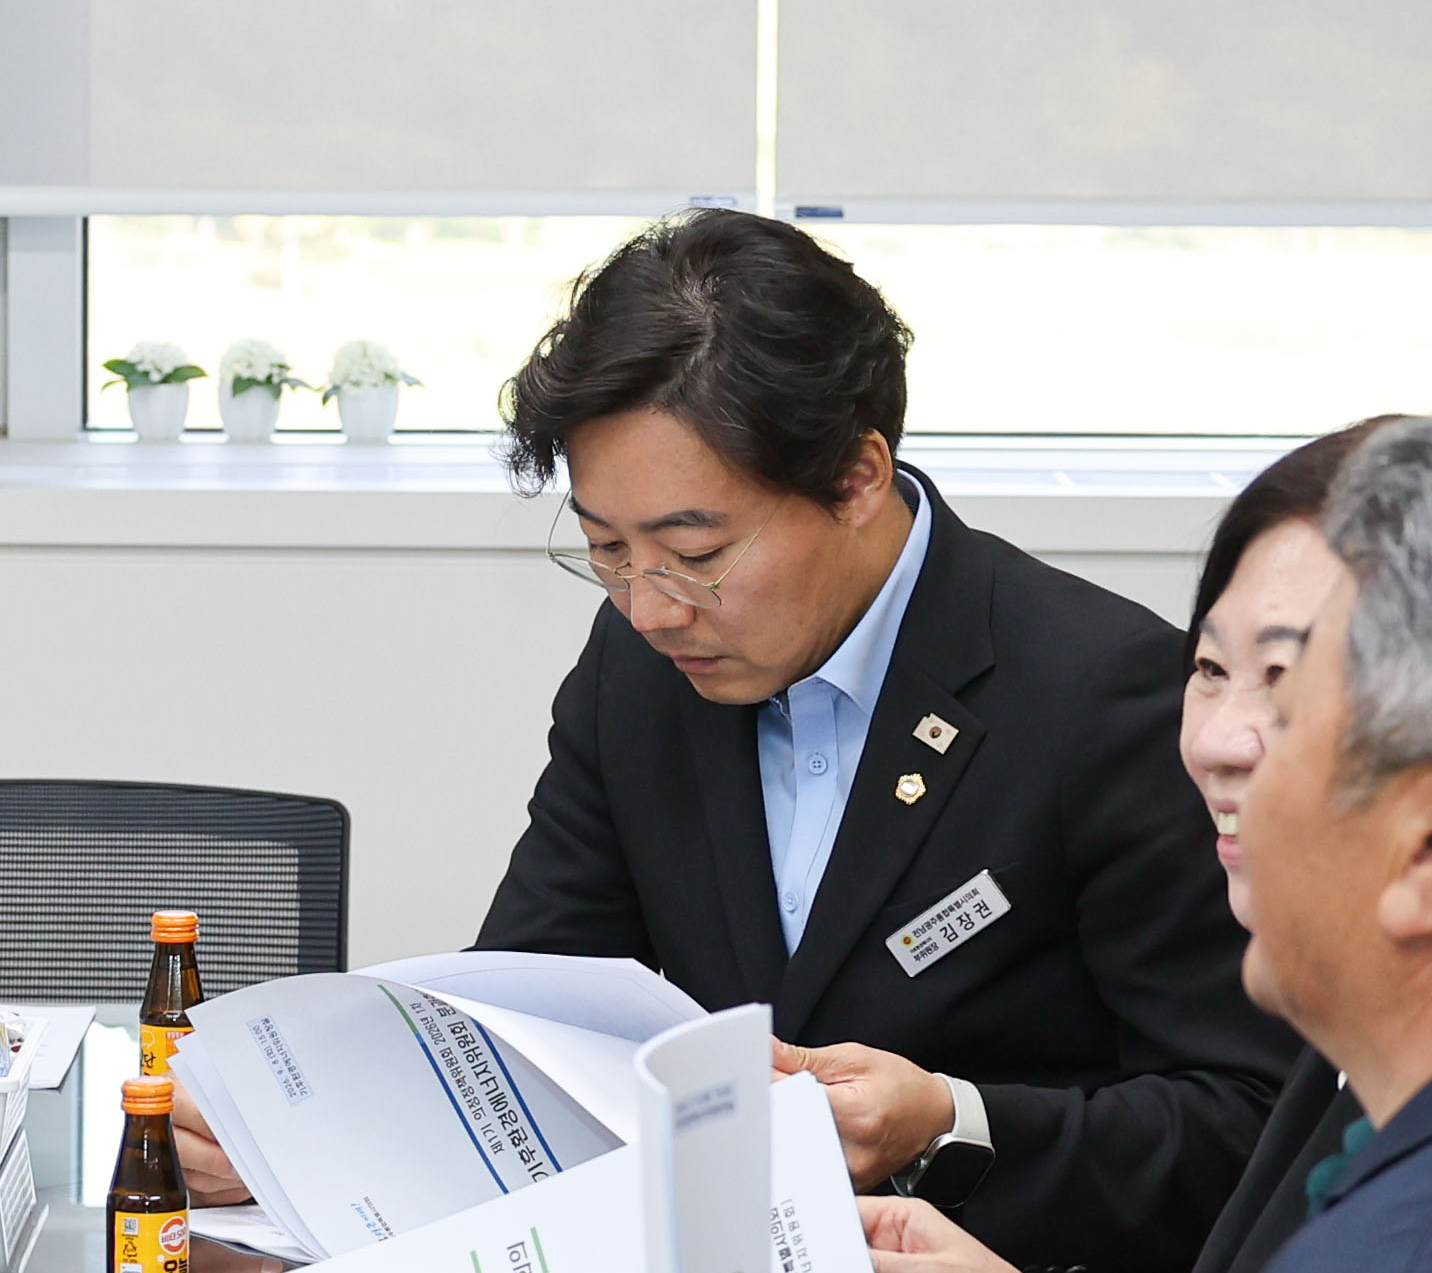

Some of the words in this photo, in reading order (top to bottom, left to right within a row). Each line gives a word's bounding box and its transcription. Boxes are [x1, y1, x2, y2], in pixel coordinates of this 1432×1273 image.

[420, 1015, 445, 1045] 2026년
[439, 1047, 485, 1120] 의정정책위원회
[447, 1021, 547, 1181] 기후환경에너지위원회
[480, 1122, 504, 1154] 제1기
